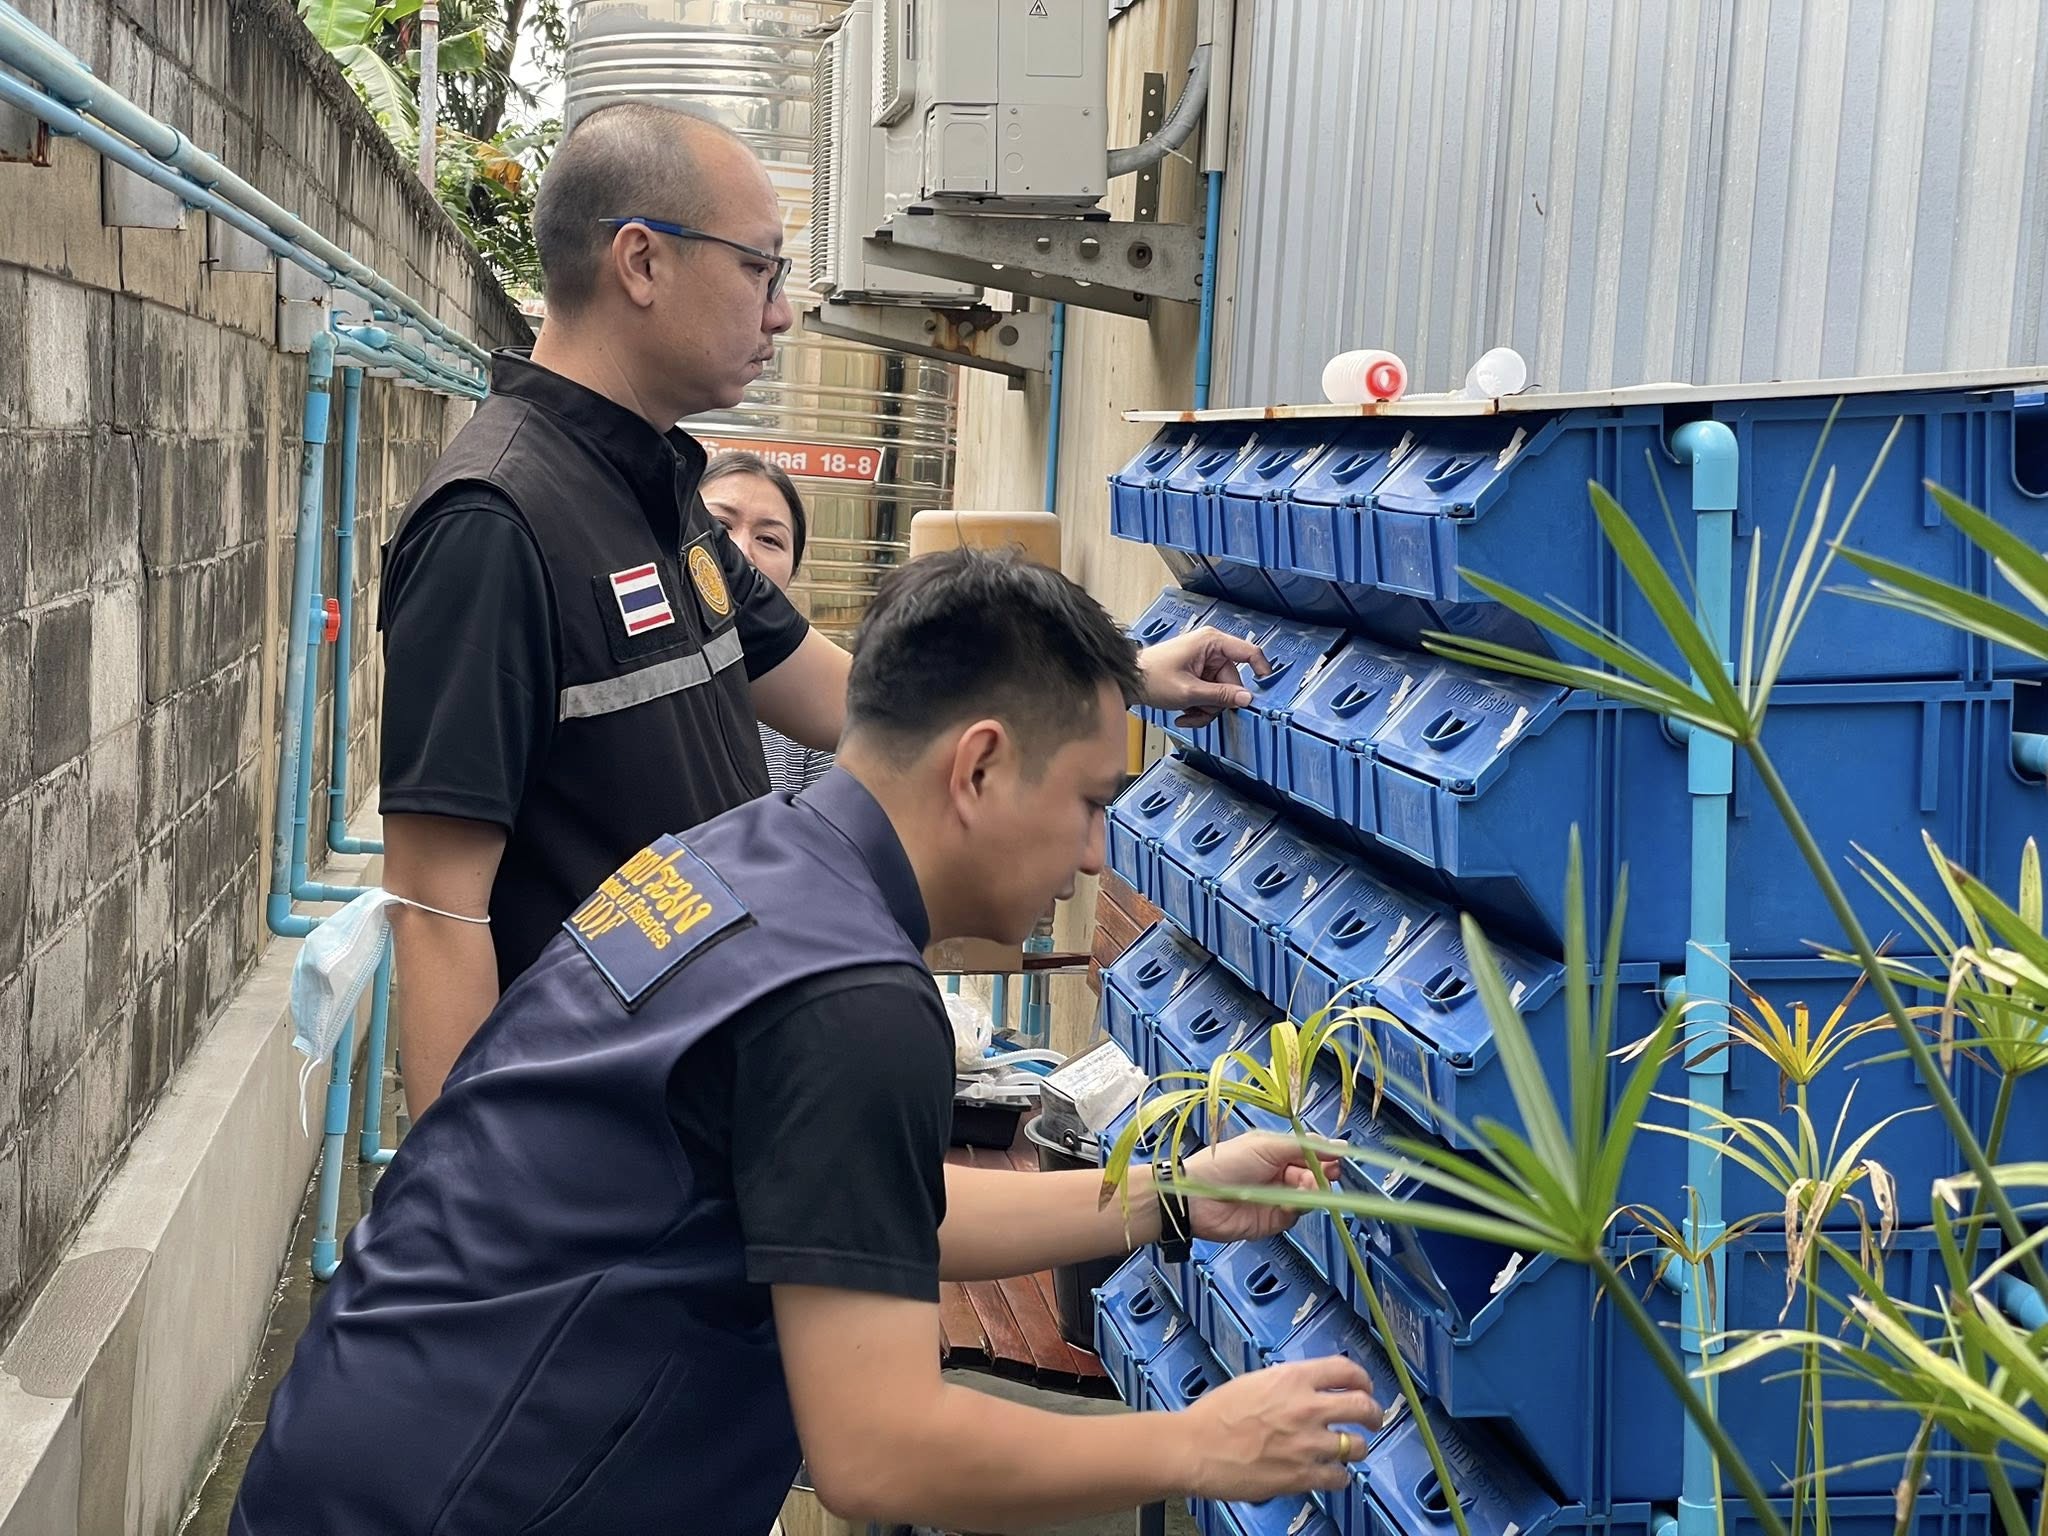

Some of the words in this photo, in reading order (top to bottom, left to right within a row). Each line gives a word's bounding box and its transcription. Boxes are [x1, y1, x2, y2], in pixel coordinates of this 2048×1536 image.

[820, 453, 871, 475] 18-8
[1352, 657, 1377, 678] Win
[1446, 682, 1475, 704] Win
[1473, 691, 1517, 716] vision
[1276, 840, 1296, 860] Win
[1293, 852, 1321, 873] vision
[616, 893, 640, 908] of
[1352, 883, 1376, 905] Win
[571, 893, 628, 941] DOF
